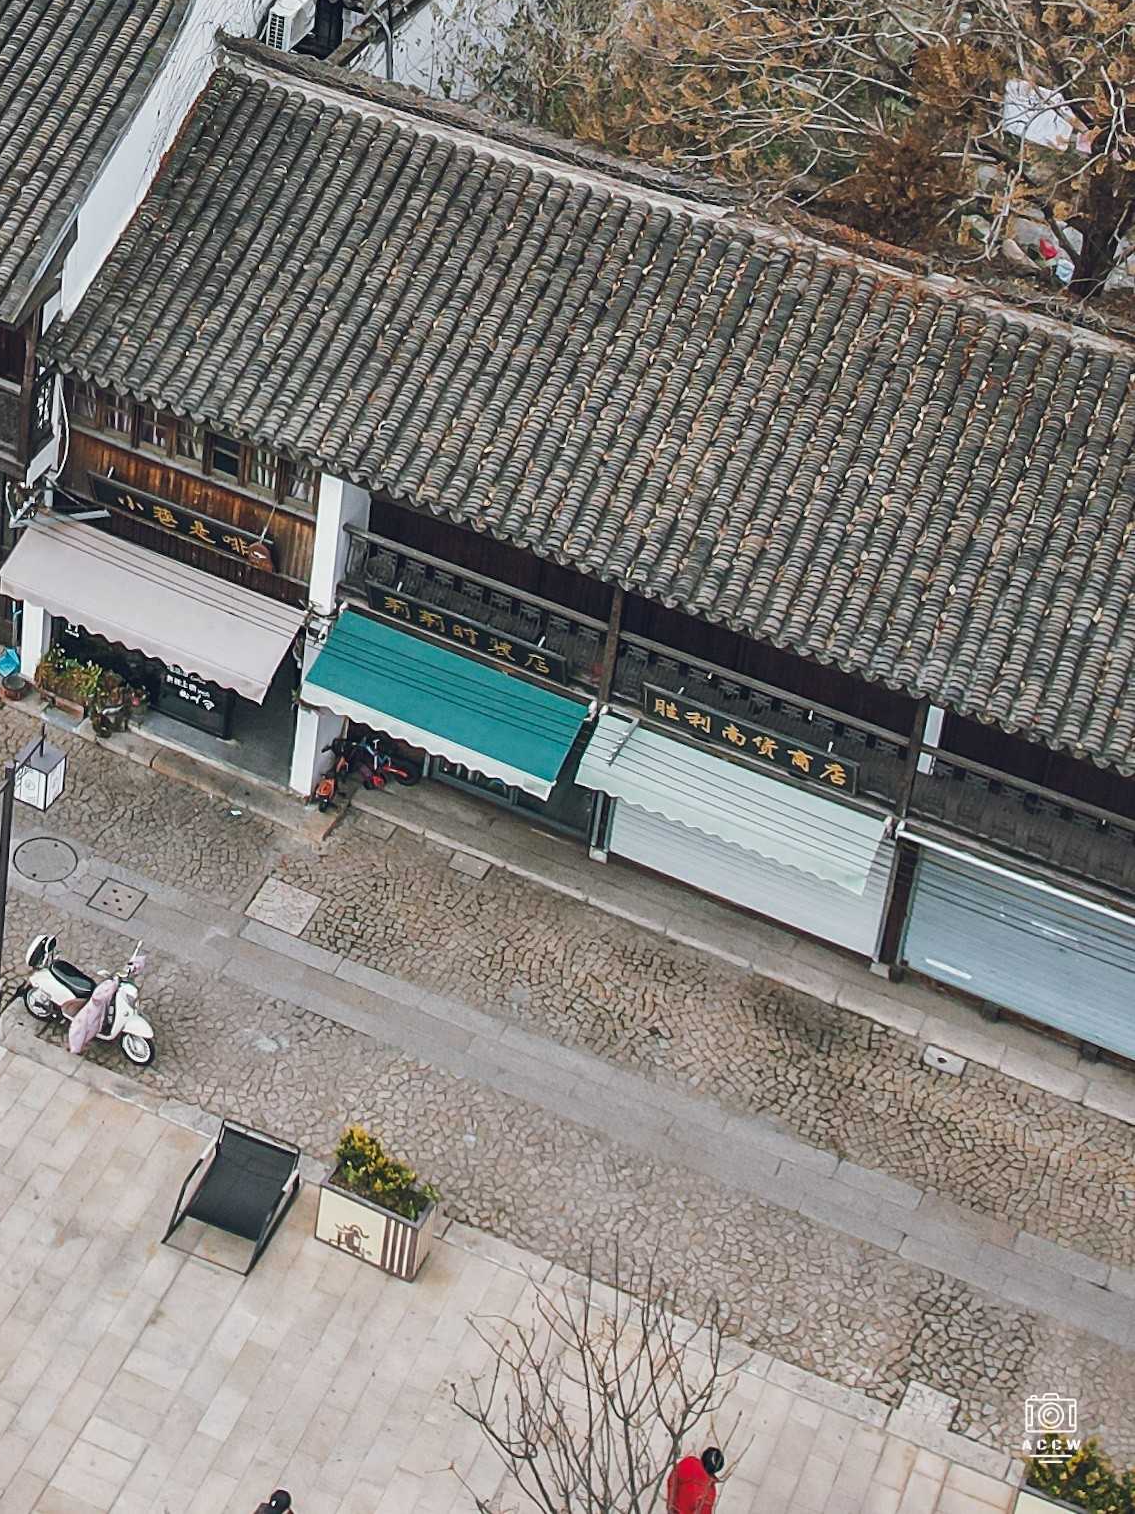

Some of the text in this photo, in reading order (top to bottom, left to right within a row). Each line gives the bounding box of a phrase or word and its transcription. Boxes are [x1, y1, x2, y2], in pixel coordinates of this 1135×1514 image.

[653, 698, 847, 786] 胜利南货商店
